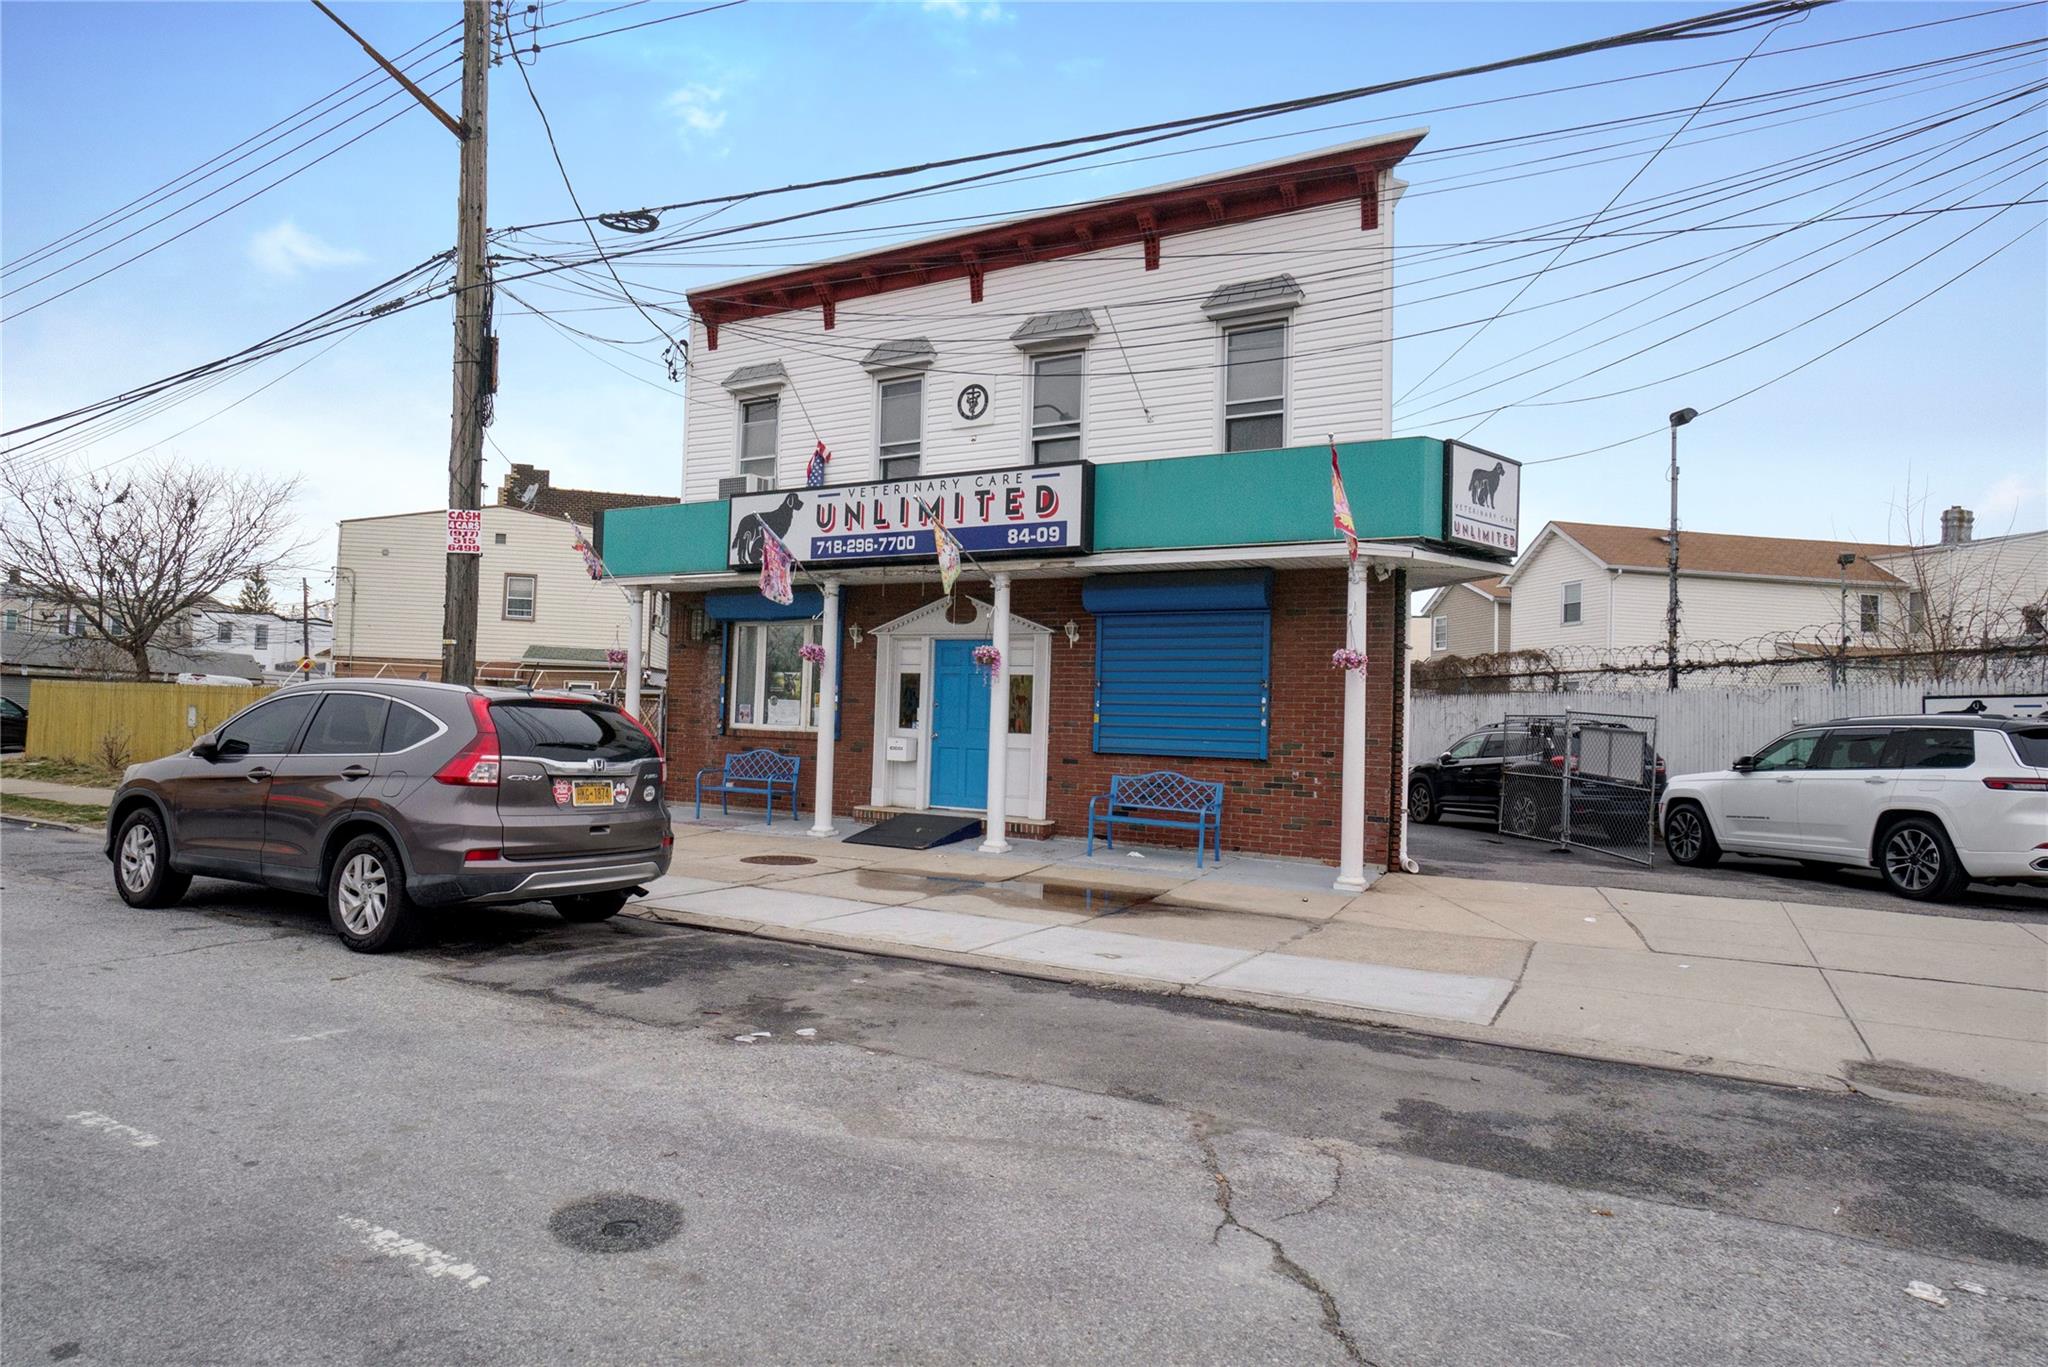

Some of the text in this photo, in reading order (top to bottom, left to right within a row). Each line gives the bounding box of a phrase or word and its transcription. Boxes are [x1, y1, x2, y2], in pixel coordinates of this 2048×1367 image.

[848, 473, 1023, 498] VETERINARY CARE
[816, 484, 1060, 533] UNLIMITED
[1007, 525, 1060, 544] 84-09
[1453, 520, 1516, 548] UNLIMITED
[448, 544, 480, 552] 6499
